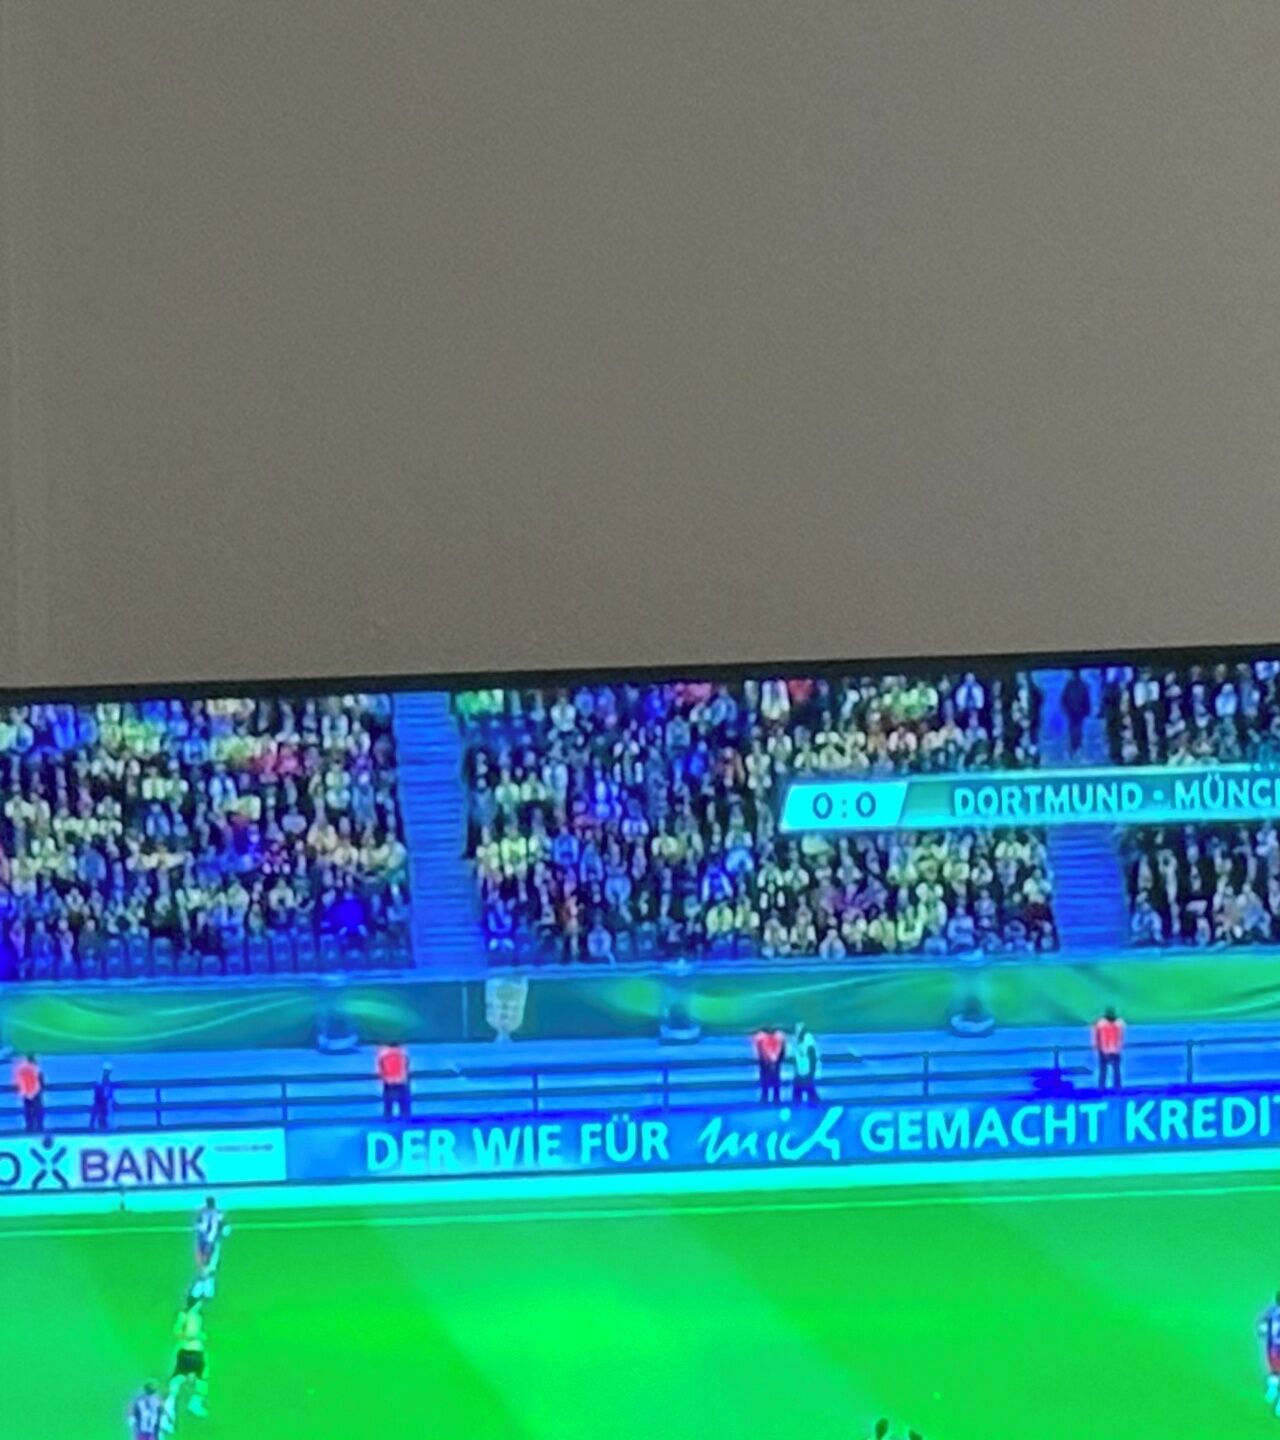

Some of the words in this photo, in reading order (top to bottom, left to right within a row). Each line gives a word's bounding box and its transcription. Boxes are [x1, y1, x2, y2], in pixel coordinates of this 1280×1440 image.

[953, 783, 1143, 818] DORTMUND
[365, 1127, 458, 1174] DER
[472, 1125, 564, 1167] WIE
[579, 1113, 670, 1162] FÜR
[859, 1101, 1107, 1153] GEMACHT
